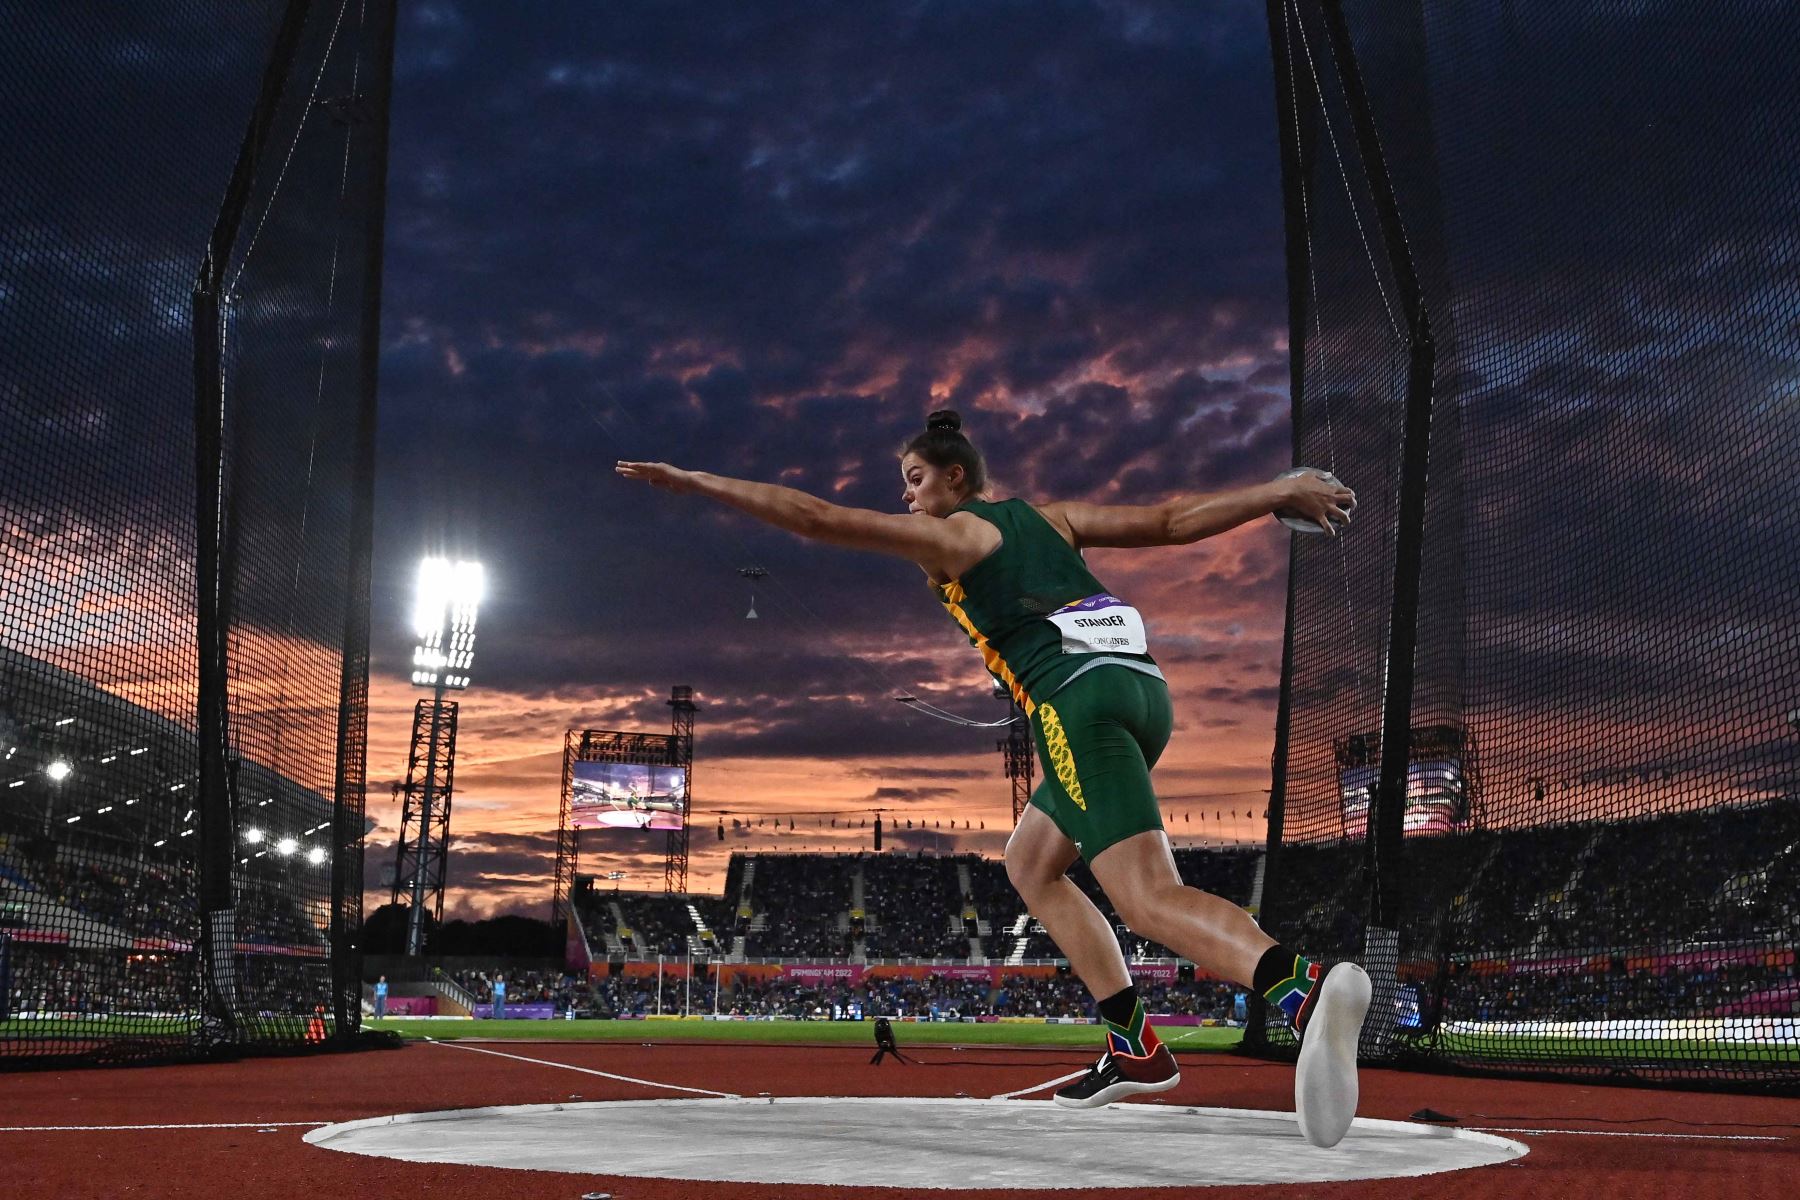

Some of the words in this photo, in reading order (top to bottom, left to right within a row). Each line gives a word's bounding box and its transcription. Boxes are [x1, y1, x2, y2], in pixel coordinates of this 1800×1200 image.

[1074, 615, 1126, 628] STANDER
[1088, 637, 1130, 645] LONGINES
[834, 968, 853, 977] 2022
[1152, 969, 1171, 978] 2022
